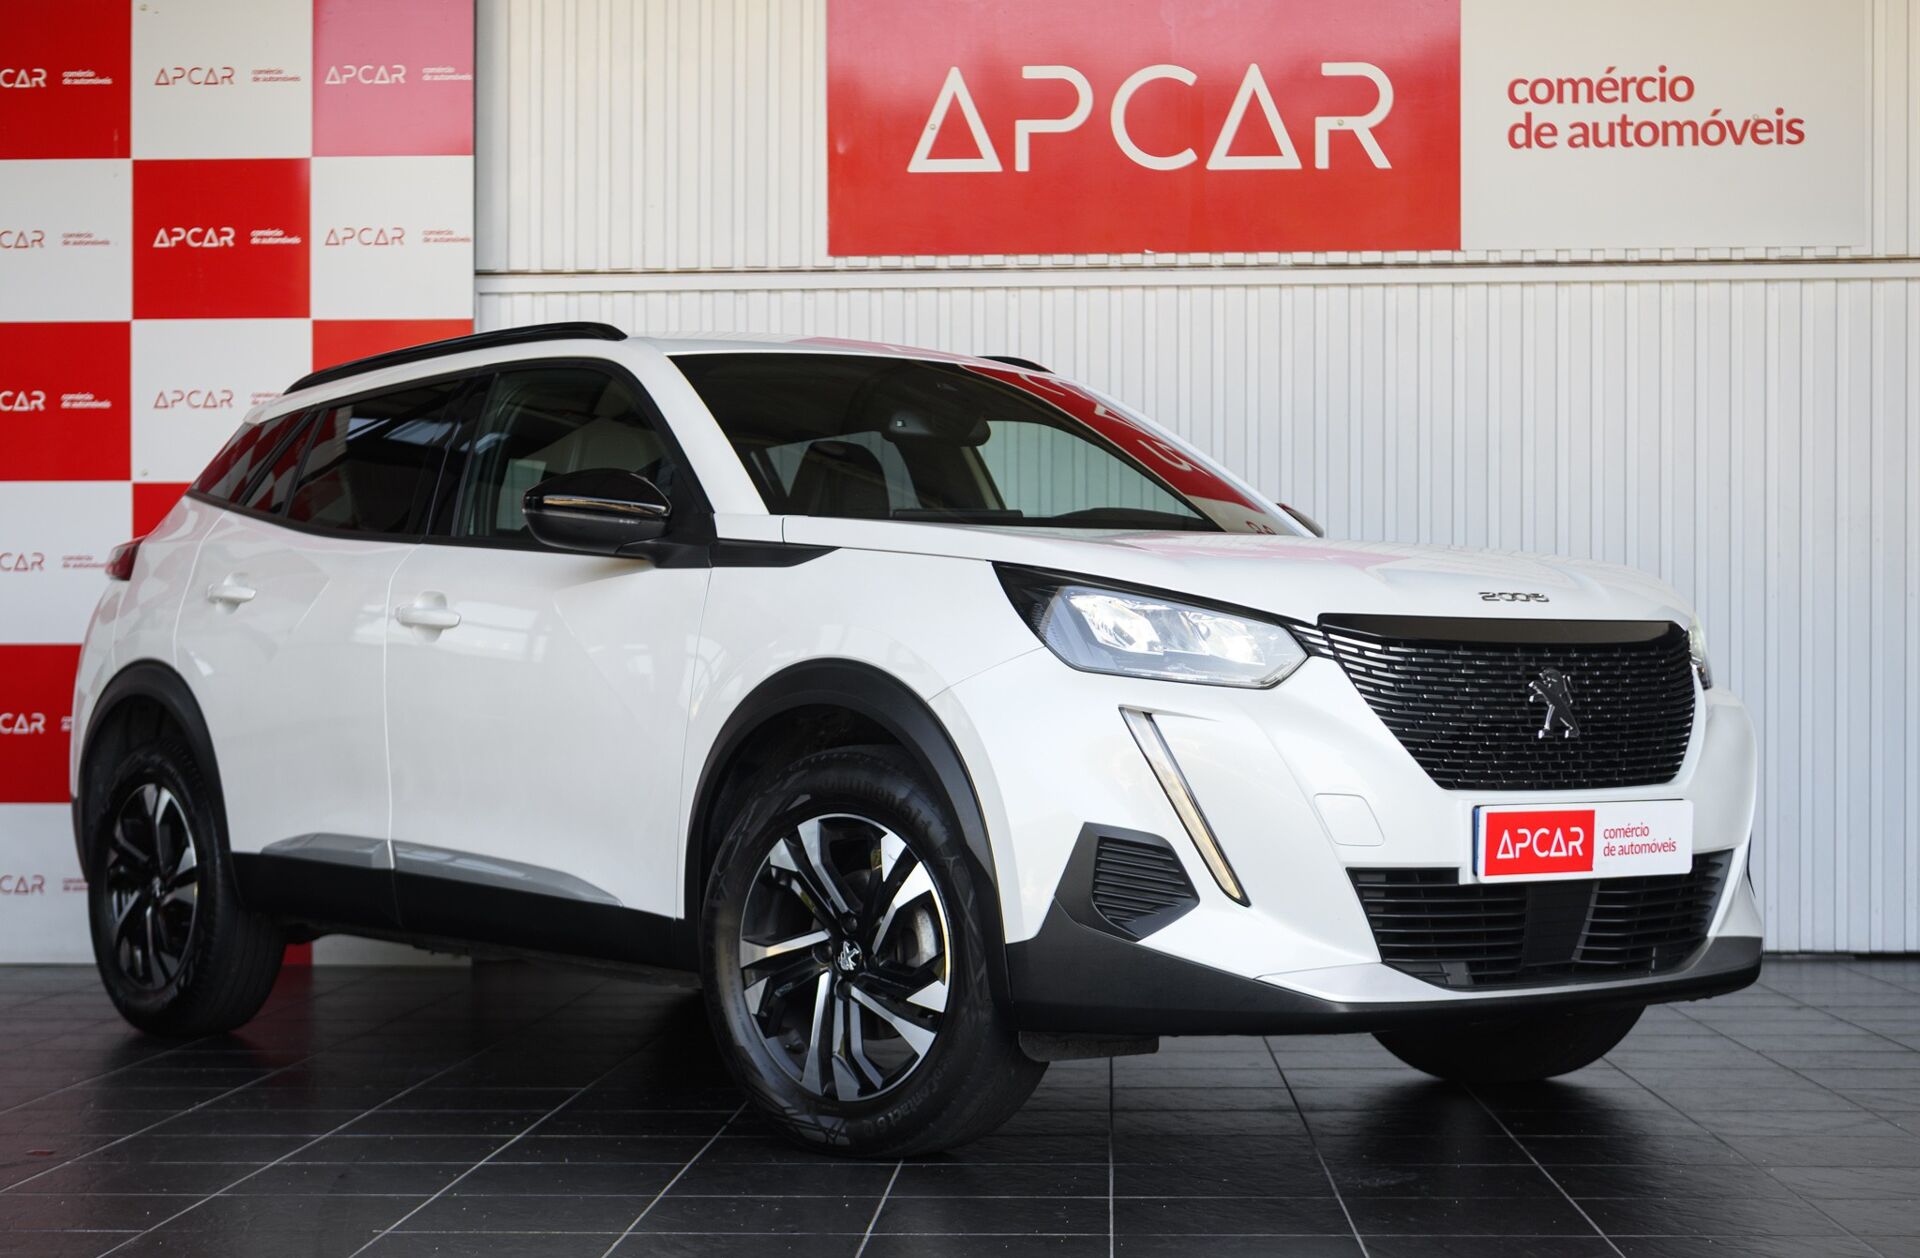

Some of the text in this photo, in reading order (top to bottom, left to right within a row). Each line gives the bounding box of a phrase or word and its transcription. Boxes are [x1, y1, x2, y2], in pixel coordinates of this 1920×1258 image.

[155, 67, 235, 86] APCAR
[325, 64, 406, 85] APCAR
[1508, 65, 1696, 106] comércio
[907, 62, 1394, 173] APCAR
[1508, 108, 1805, 150] de automóveis
[153, 227, 235, 248] APCAR
[325, 227, 405, 247] APCAR
[153, 389, 234, 409] APCAR
[1603, 822, 1650, 840] comércio
[1496, 827, 1585, 860] APCAR
[1603, 837, 1677, 857] de automóveis
